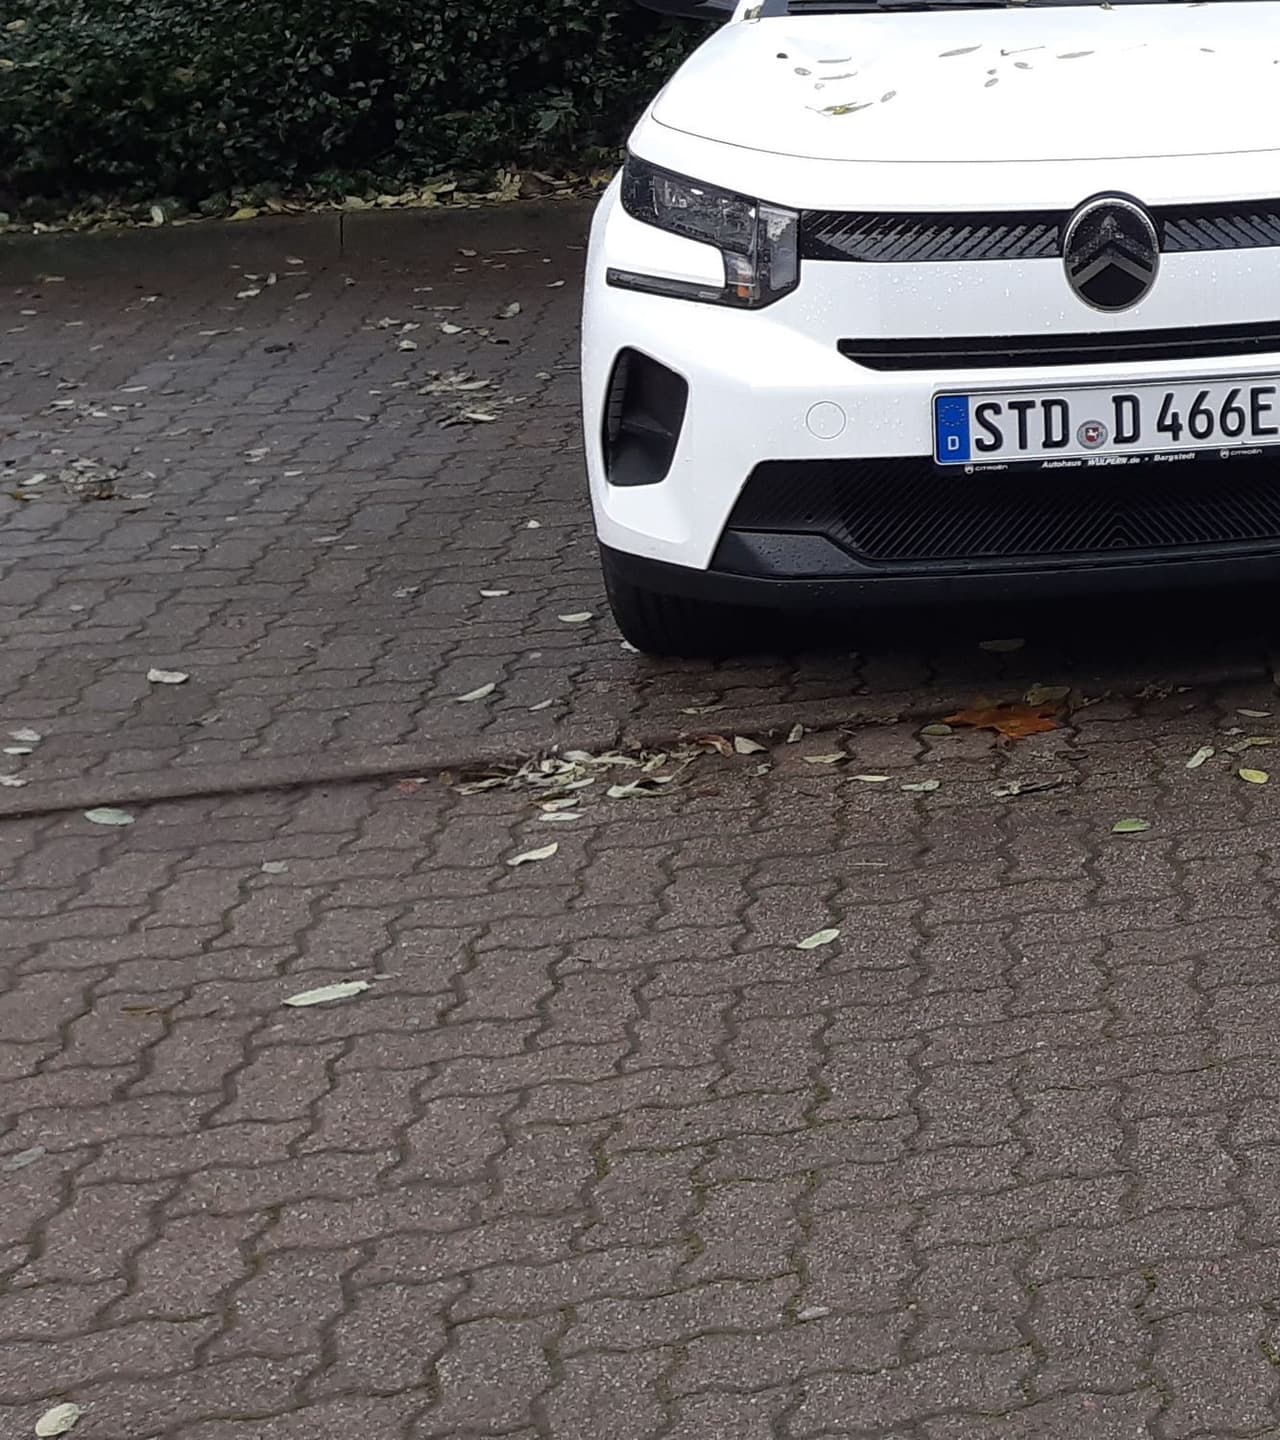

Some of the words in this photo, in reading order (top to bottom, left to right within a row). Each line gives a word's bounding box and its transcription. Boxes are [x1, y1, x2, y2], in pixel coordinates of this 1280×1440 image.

[974, 397, 1070, 453] STD
[1111, 393, 1141, 445] D
[1156, 386, 1279, 442] 466E
[947, 436, 960, 451] D
[1041, 459, 1082, 469] Autohaus
[1153, 452, 1196, 462] Bargstedt
